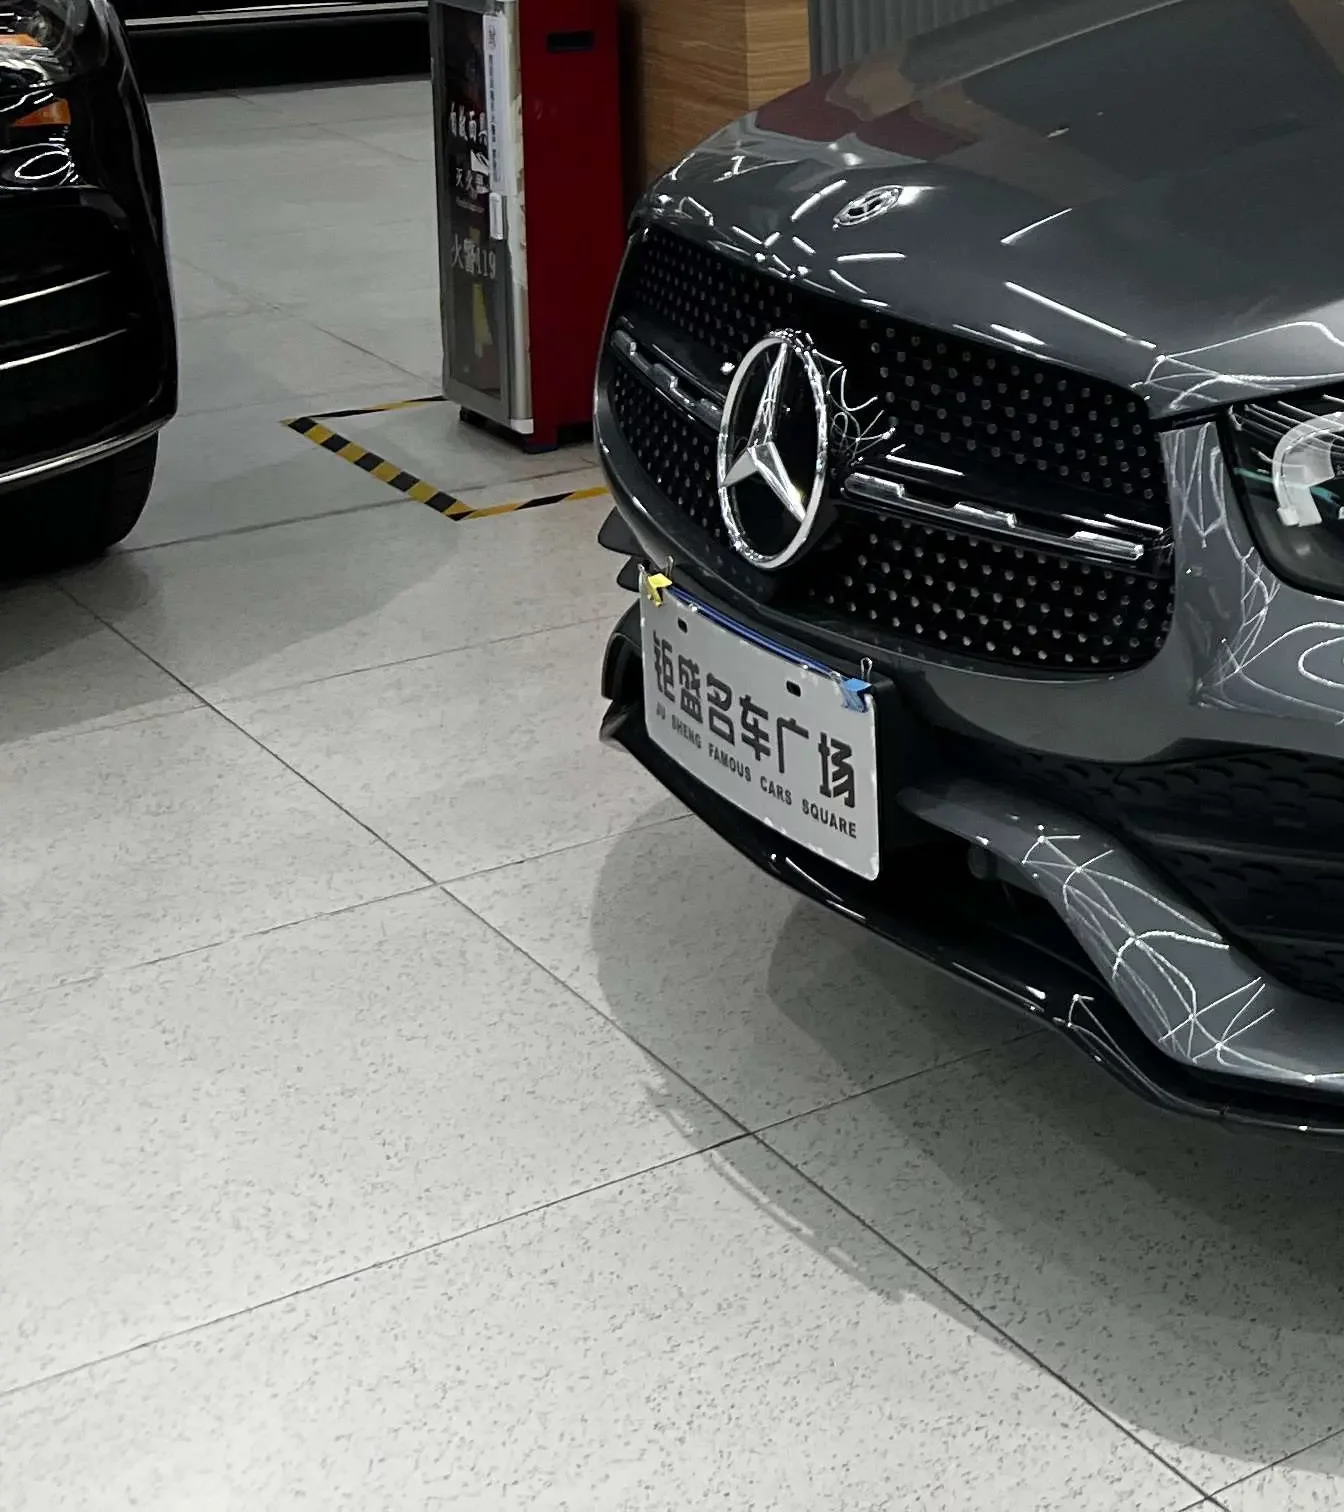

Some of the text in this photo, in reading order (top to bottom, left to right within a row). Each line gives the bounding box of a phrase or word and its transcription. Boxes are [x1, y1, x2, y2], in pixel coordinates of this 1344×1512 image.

[671, 713, 703, 749] SHENG
[708, 743, 753, 783] FAMOUS
[759, 775, 793, 806] CARS
[802, 799, 858, 839] SQUARE
